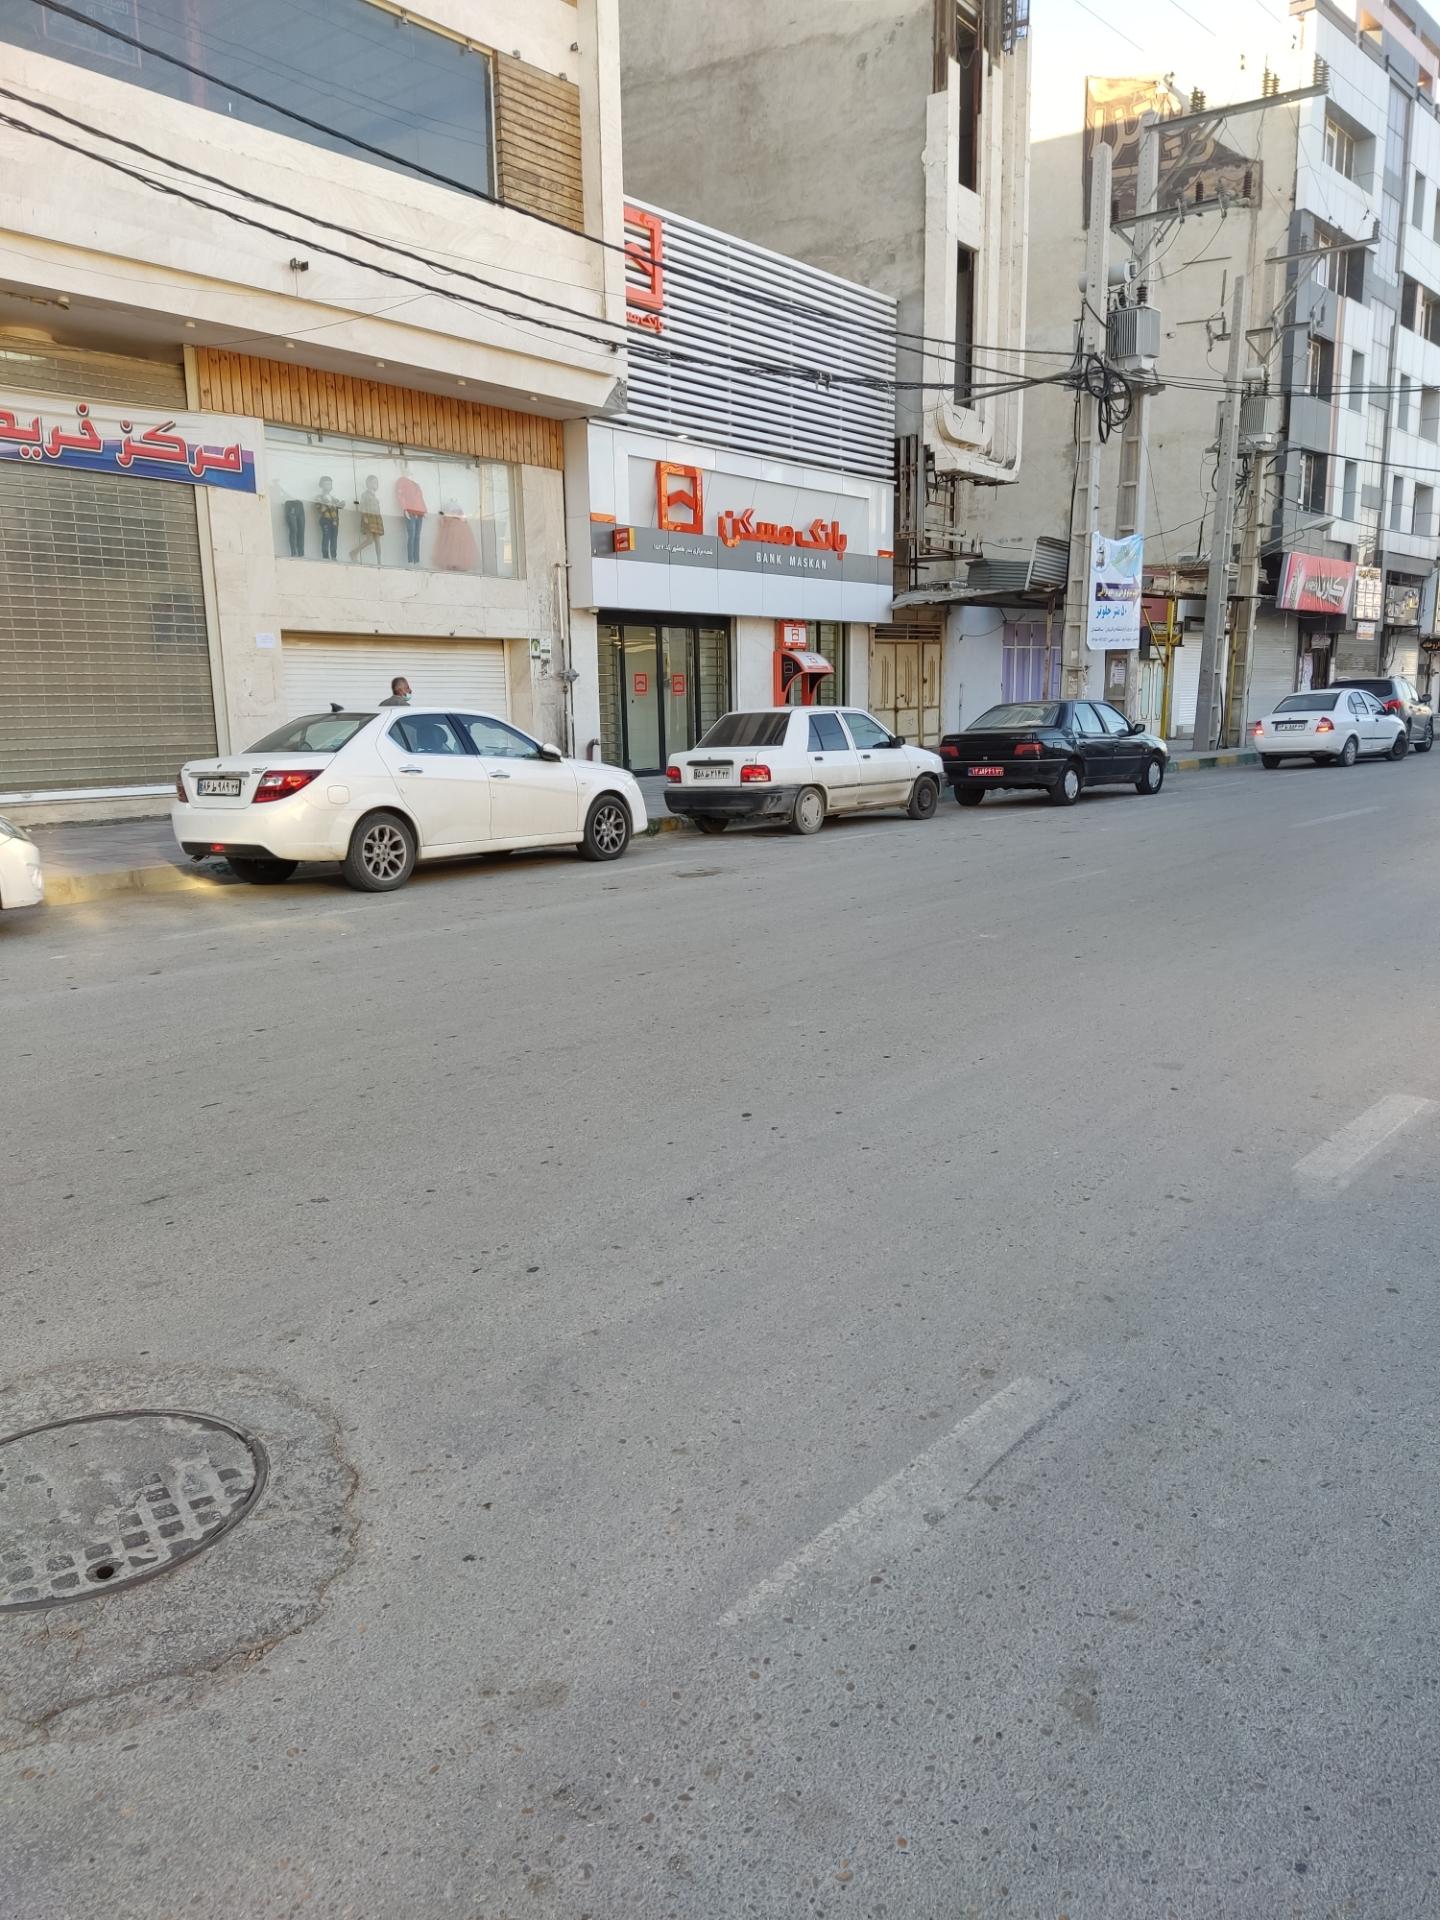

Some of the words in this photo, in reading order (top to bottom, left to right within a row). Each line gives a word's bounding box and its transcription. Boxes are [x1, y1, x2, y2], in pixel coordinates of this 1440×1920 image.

[116, 419, 242, 477] مرکز
[717, 508, 795, 548] مسکن
[795, 518, 847, 560] بانک
[756, 551, 782, 564] BANK
[789, 556, 828, 570] MASKAN
